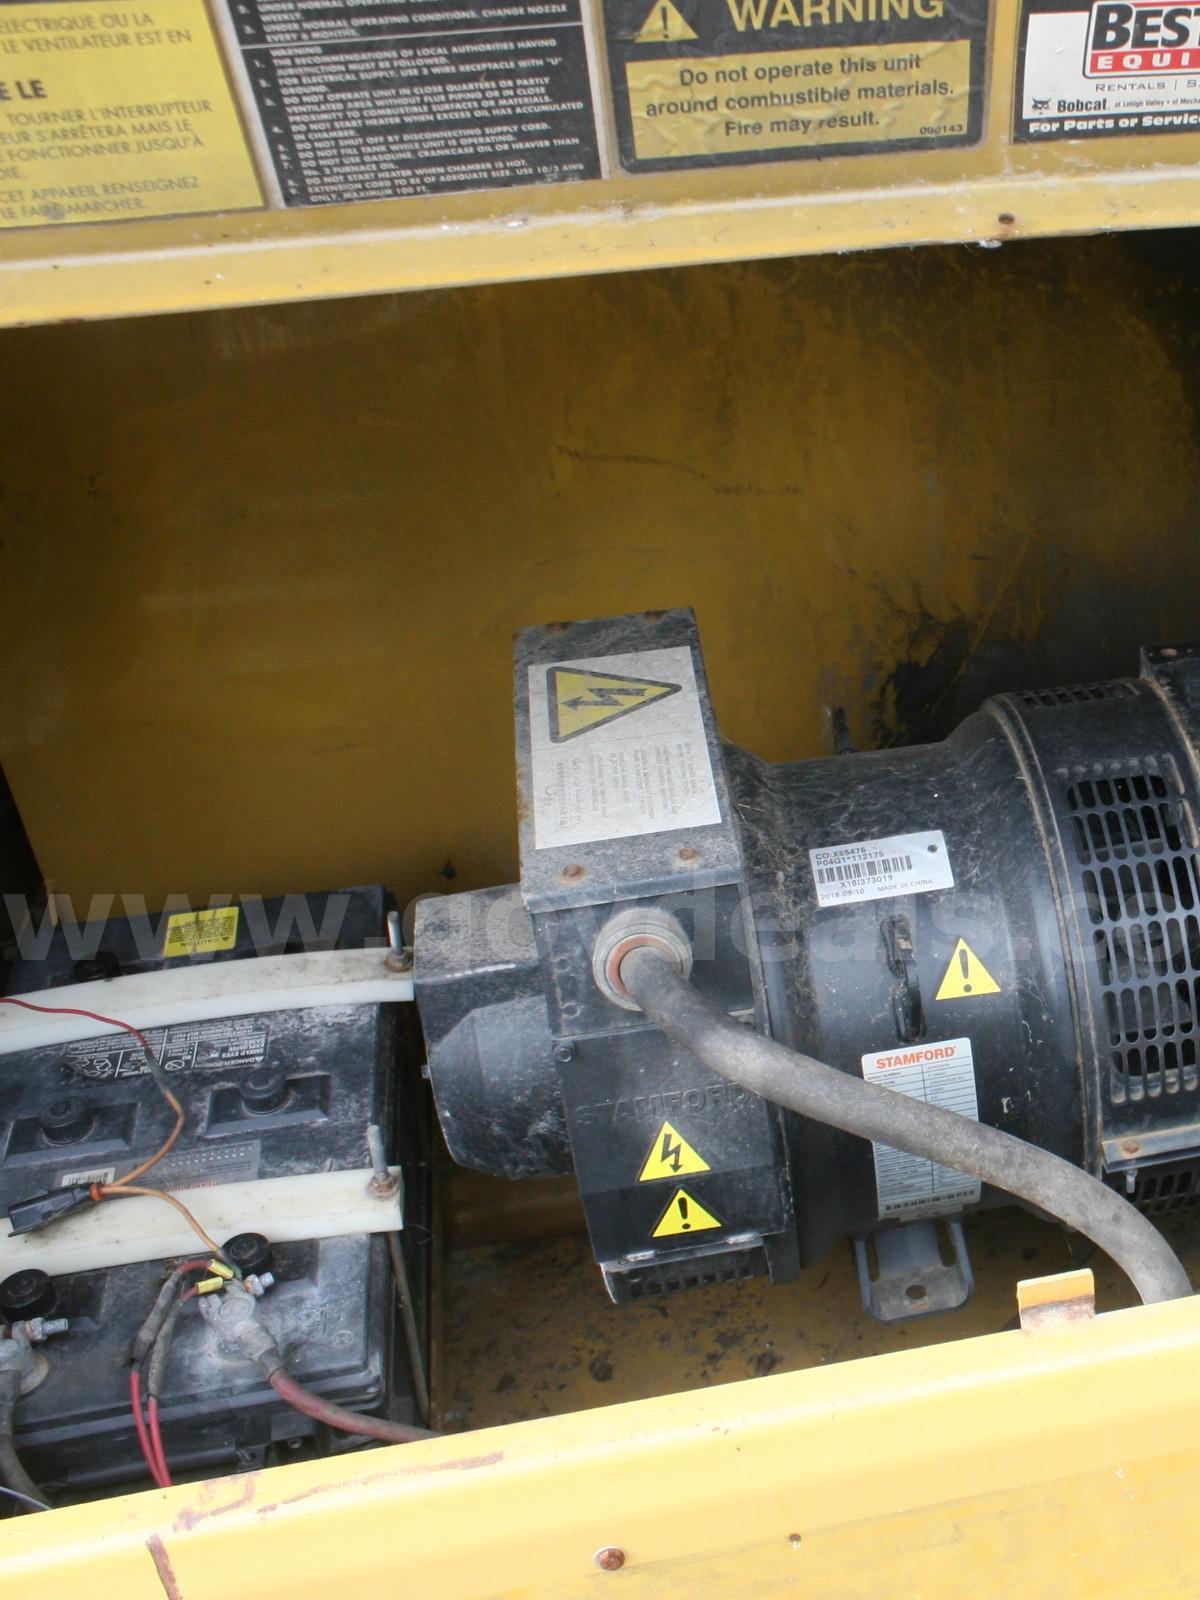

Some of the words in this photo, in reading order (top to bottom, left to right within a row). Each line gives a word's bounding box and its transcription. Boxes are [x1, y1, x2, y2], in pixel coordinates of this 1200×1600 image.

[526, 4, 567, 13] NOZZLE
[99, 12, 129, 29] OU
[132, 11, 154, 26] LA
[1, 38, 20, 53] LE
[22, 32, 131, 52] VENTILATEUR
[134, 30, 164, 45] EST
[166, 29, 193, 43] EN
[680, 69, 708, 86] Do
[715, 66, 747, 82] not
[754, 64, 833, 83] operate
[839, 57, 877, 73] this
[883, 53, 921, 70] unit
[15, 79, 47, 100] LE
[1095, 81, 1166, 92] RENTALS
[646, 97, 719, 117] around
[725, 87, 850, 111] combustible
[857, 80, 954, 101] materials.
[1057, 98, 1107, 113] Bobcat
[6, 108, 85, 127] TOURNER
[88, 99, 213, 120] L'INTERRUPTEUR
[725, 119, 764, 137] Fire
[770, 117, 811, 136] may
[818, 111, 879, 129] result.
[130, 120, 173, 135] MAIS
[175, 118, 193, 132] LE
[1029, 121, 1060, 134] For
[1064, 118, 1114, 132] Parts
[1119, 117, 1138, 128] or
[8, 141, 131, 163] FONCTIONNER
[553, 138, 579, 147] THAN
[31, 184, 96, 200] APPAREIL
[101, 175, 201, 195] RENSEIGNEZ
[0, 206, 16, 220] LE
[66, 196, 143, 214] MARCHER
[875, 1046, 955, 1069] STAMFORD
